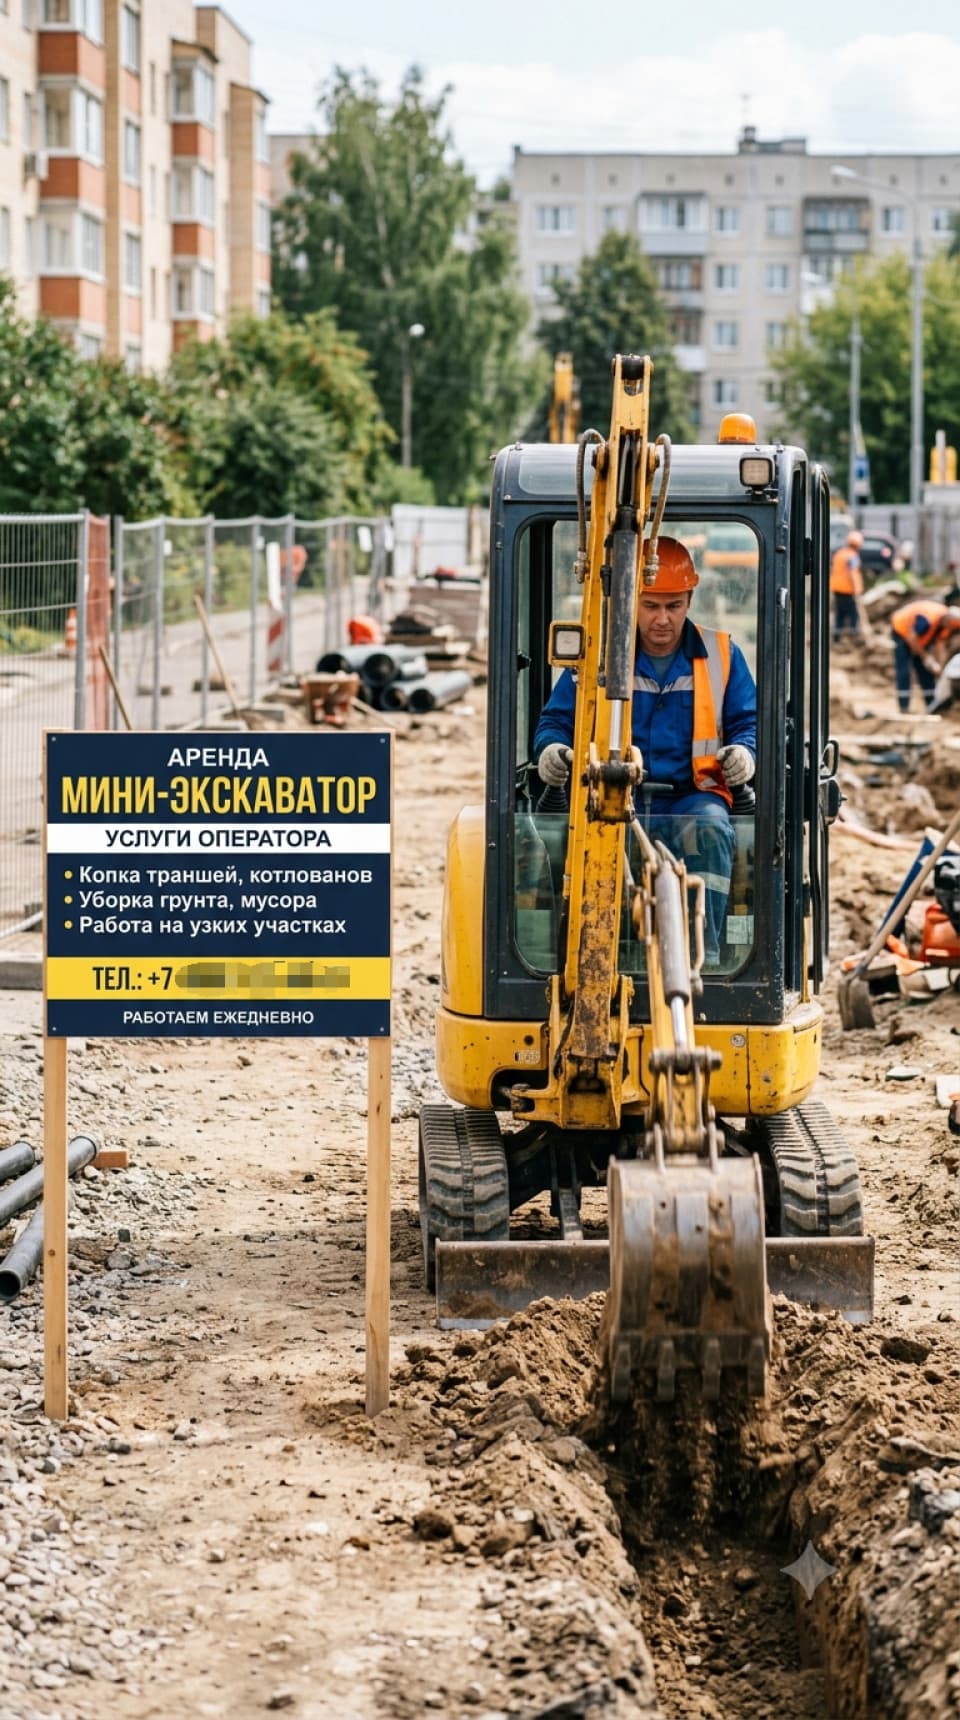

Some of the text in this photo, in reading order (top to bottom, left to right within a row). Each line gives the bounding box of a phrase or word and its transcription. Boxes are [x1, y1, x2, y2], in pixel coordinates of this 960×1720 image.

[167, 748, 270, 770] АРЕНДА
[62, 776, 376, 814] МИНИ-ЭКСКАВАТОР
[105, 829, 332, 847] УСЛУГИ ОПЕРАТОРА
[79, 866, 373, 887] Копка траншей, котлованов
[79, 891, 317, 912] Уборка грунта, мусора
[79, 916, 347, 937] Работа на узких участках
[92, 966, 142, 990] ТЕЛ.:
[123, 1010, 315, 1026] РАБОТАЕМ ЕЖЕДНЕВНО
